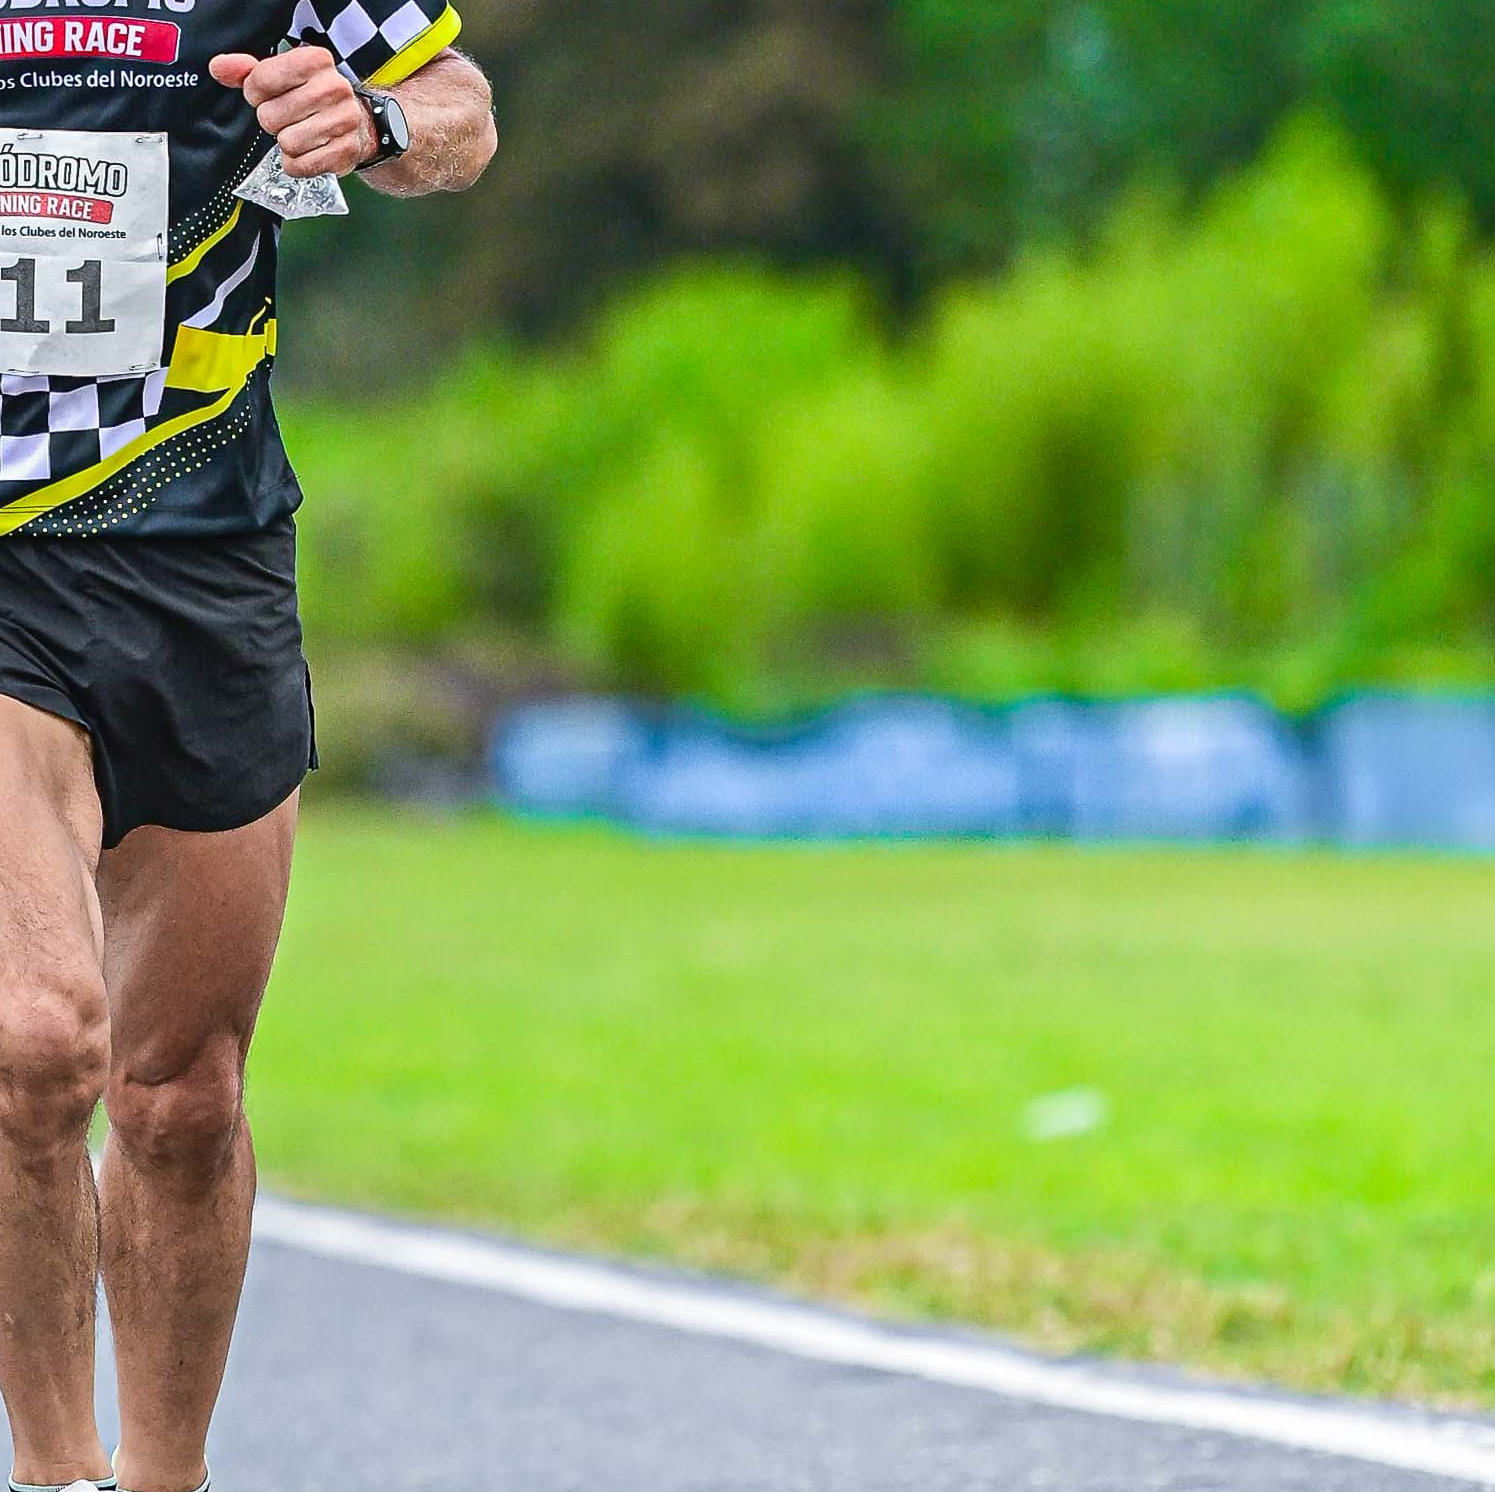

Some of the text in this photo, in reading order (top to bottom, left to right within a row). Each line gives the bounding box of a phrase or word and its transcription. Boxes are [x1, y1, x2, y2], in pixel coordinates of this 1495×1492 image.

[64, 20, 146, 58] RACE
[20, 71, 83, 88] Clubes
[86, 70, 115, 88] del
[120, 70, 199, 88] Noroeste
[46, 195, 95, 221] RACE
[1, 224, 17, 236] los
[19, 225, 57, 238] Clubes
[58, 226, 76, 238] del
[78, 227, 127, 239] Noroeste
